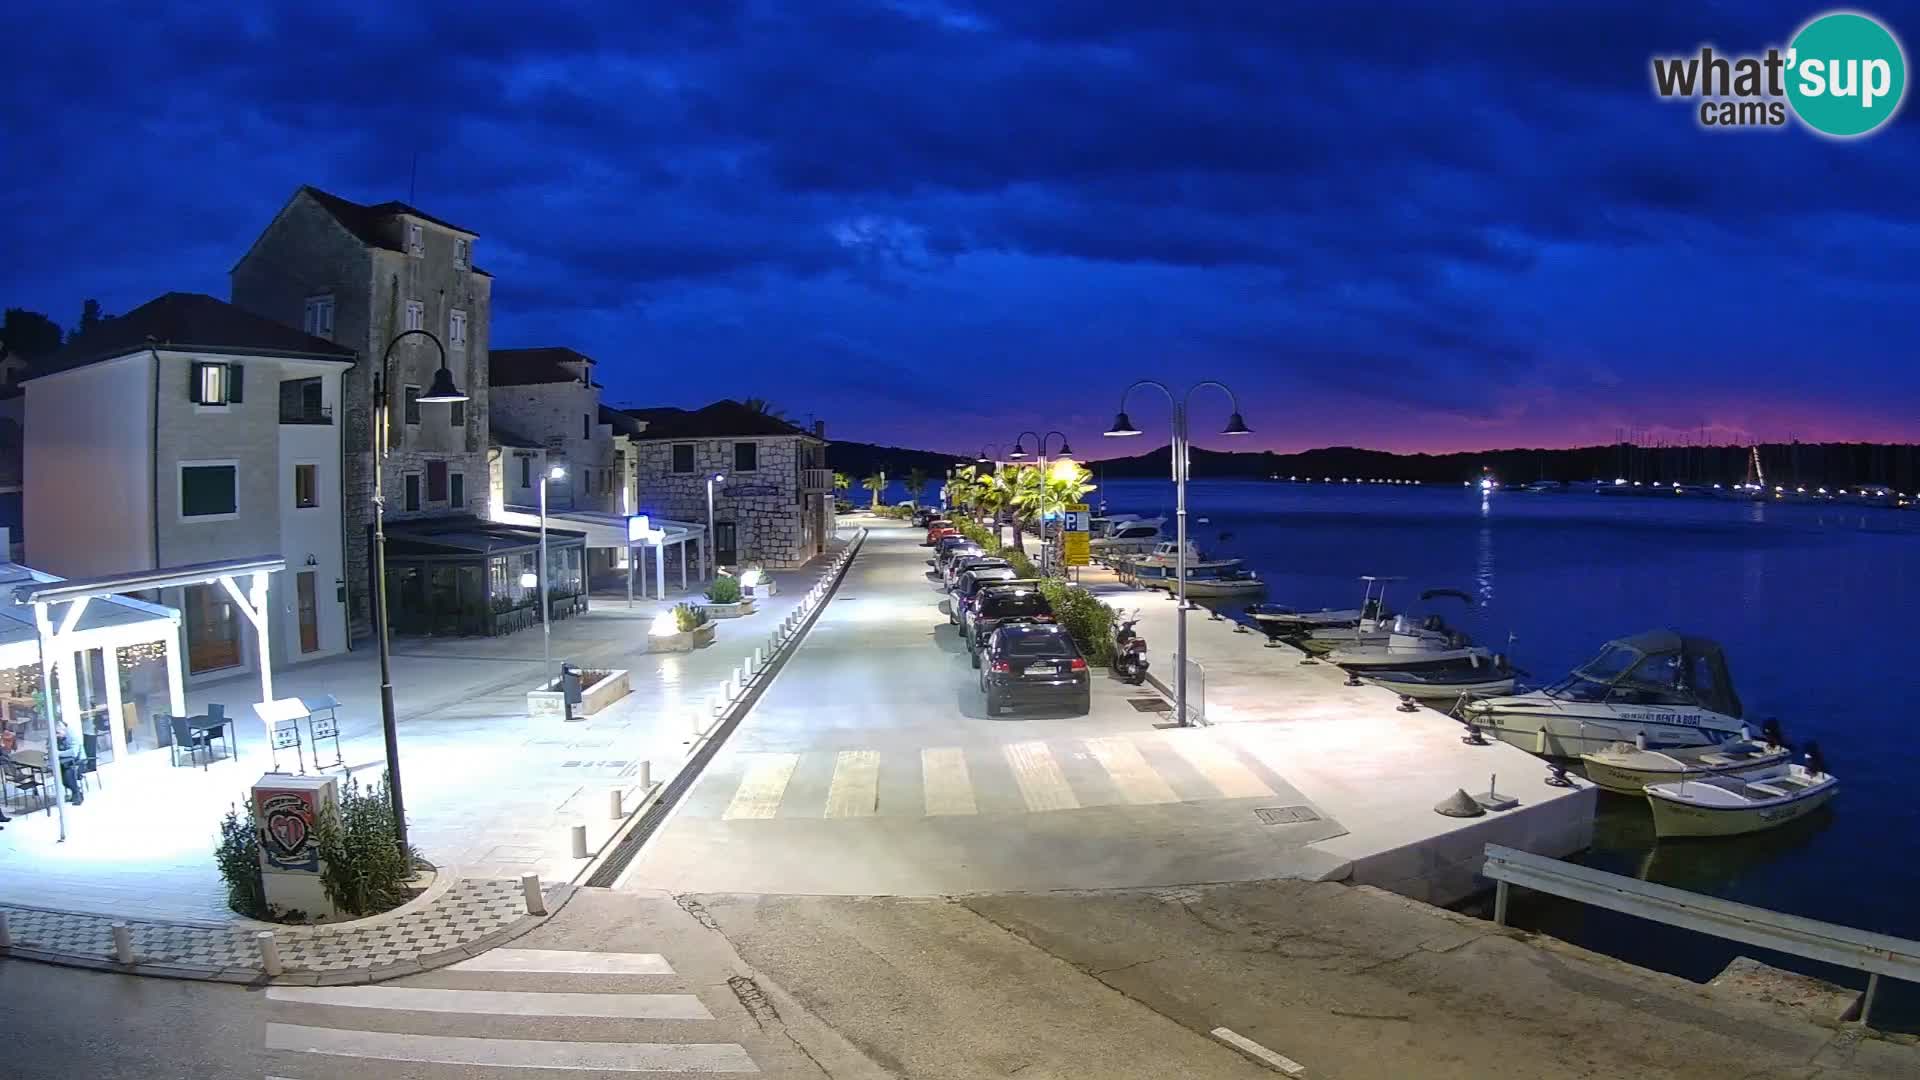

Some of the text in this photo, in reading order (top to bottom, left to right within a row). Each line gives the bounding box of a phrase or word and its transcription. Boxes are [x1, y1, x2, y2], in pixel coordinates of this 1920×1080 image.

[1066, 513, 1076, 530] P
[1656, 713, 1677, 723] RENT
[1683, 714, 1701, 726] BOAT
